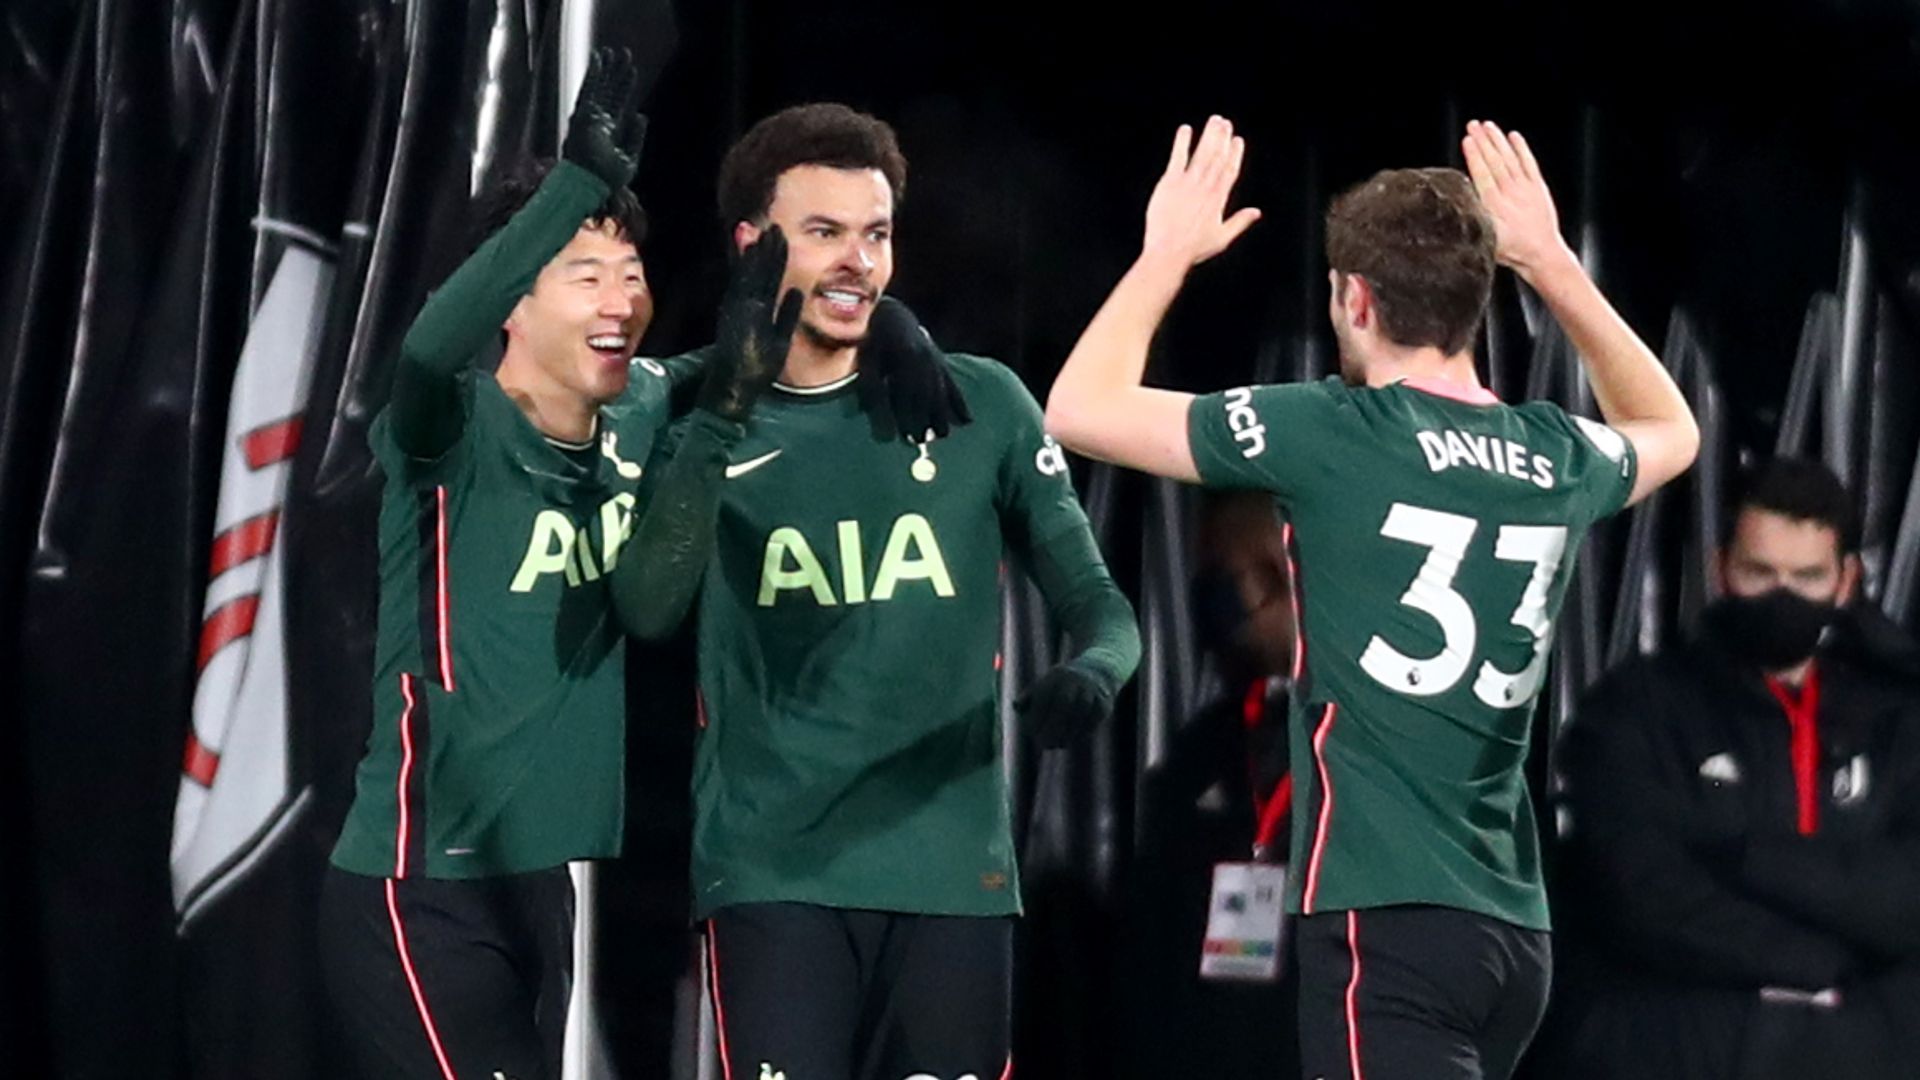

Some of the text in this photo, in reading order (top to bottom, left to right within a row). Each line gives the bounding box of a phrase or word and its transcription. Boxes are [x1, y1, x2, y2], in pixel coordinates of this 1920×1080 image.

[1224, 386, 1266, 459] nch
[1416, 429, 1555, 490] DAVIES
[759, 513, 956, 606] AIA
[1359, 502, 1569, 710] 33
